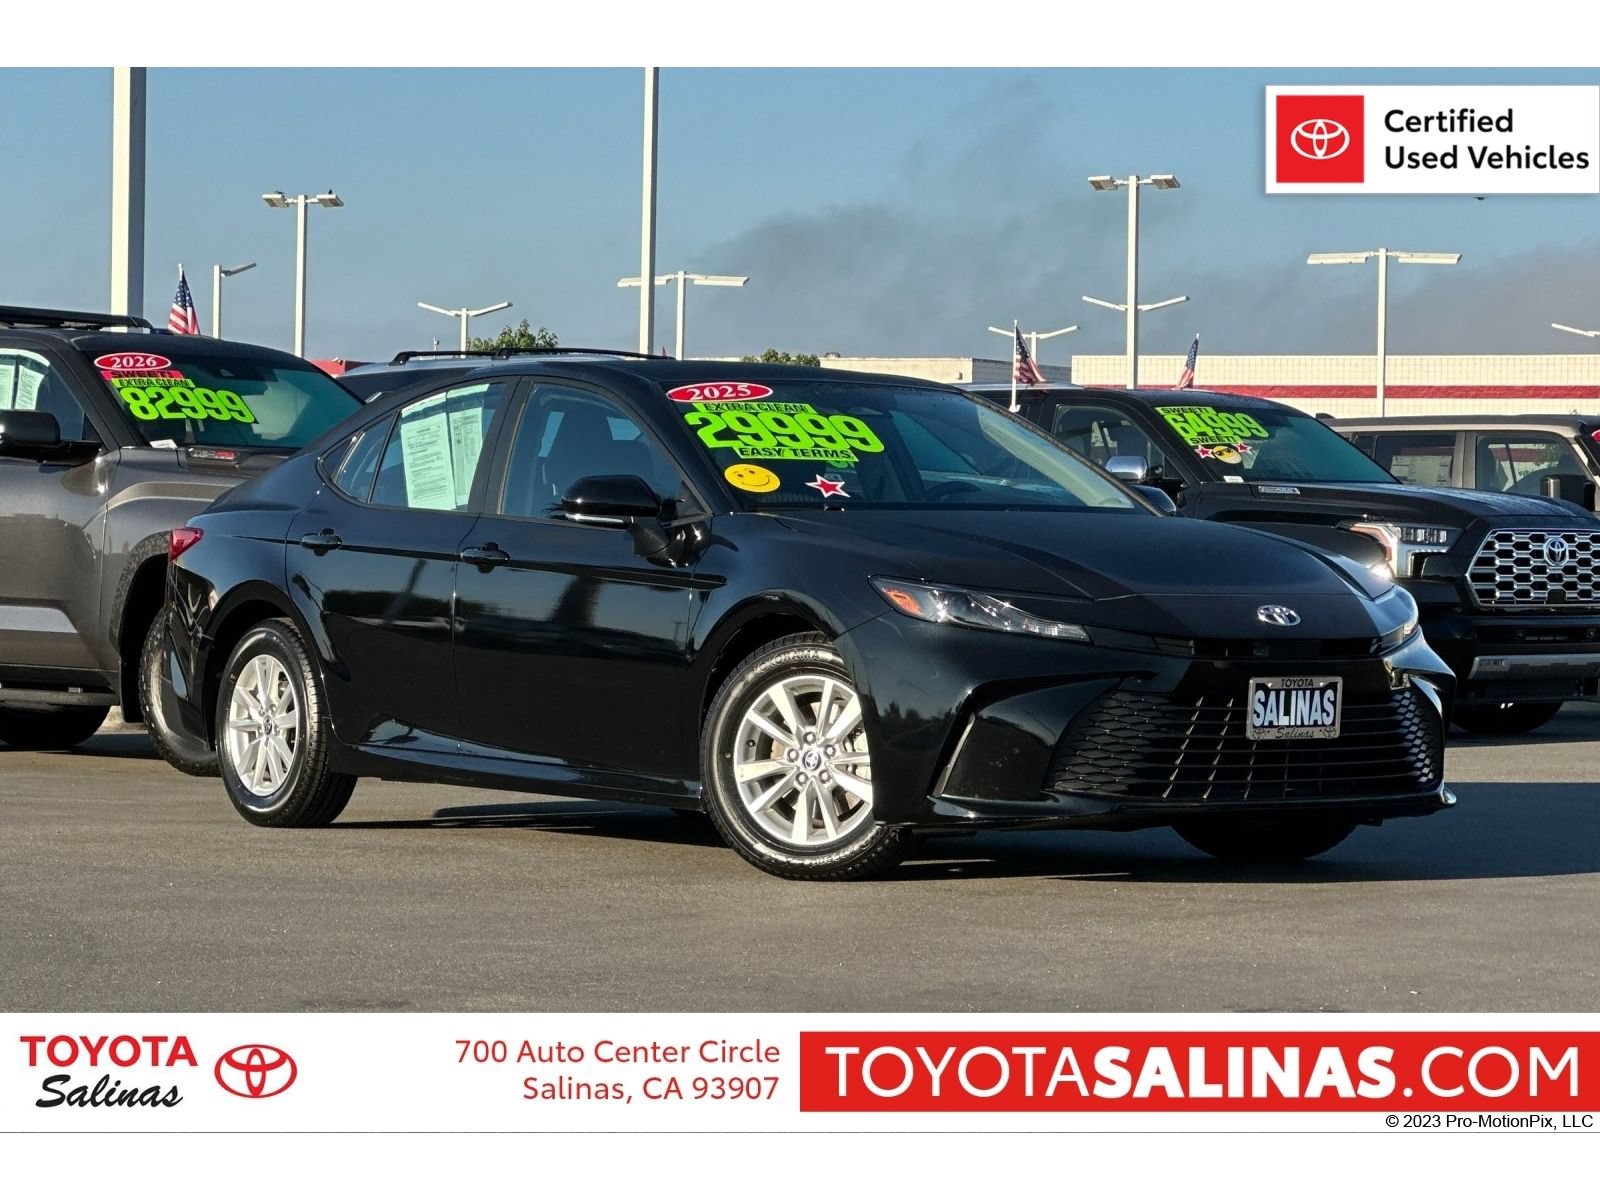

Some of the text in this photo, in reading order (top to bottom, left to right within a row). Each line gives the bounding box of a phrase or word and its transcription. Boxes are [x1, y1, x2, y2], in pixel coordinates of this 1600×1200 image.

[110, 356, 157, 368] 2026
[119, 378, 189, 388] EXTRA CLEAN
[686, 384, 751, 400] 2025
[119, 387, 255, 423] 82999
[703, 402, 806, 413] EXTRA CLEAN
[1163, 412, 1270, 438] 64999
[684, 410, 884, 453] 29999
[739, 447, 852, 459] EASY TERMS
[1281, 678, 1314, 688] TOYOTA
[1253, 689, 1335, 727] SALINAS
[1275, 727, 1314, 739] Salinas
